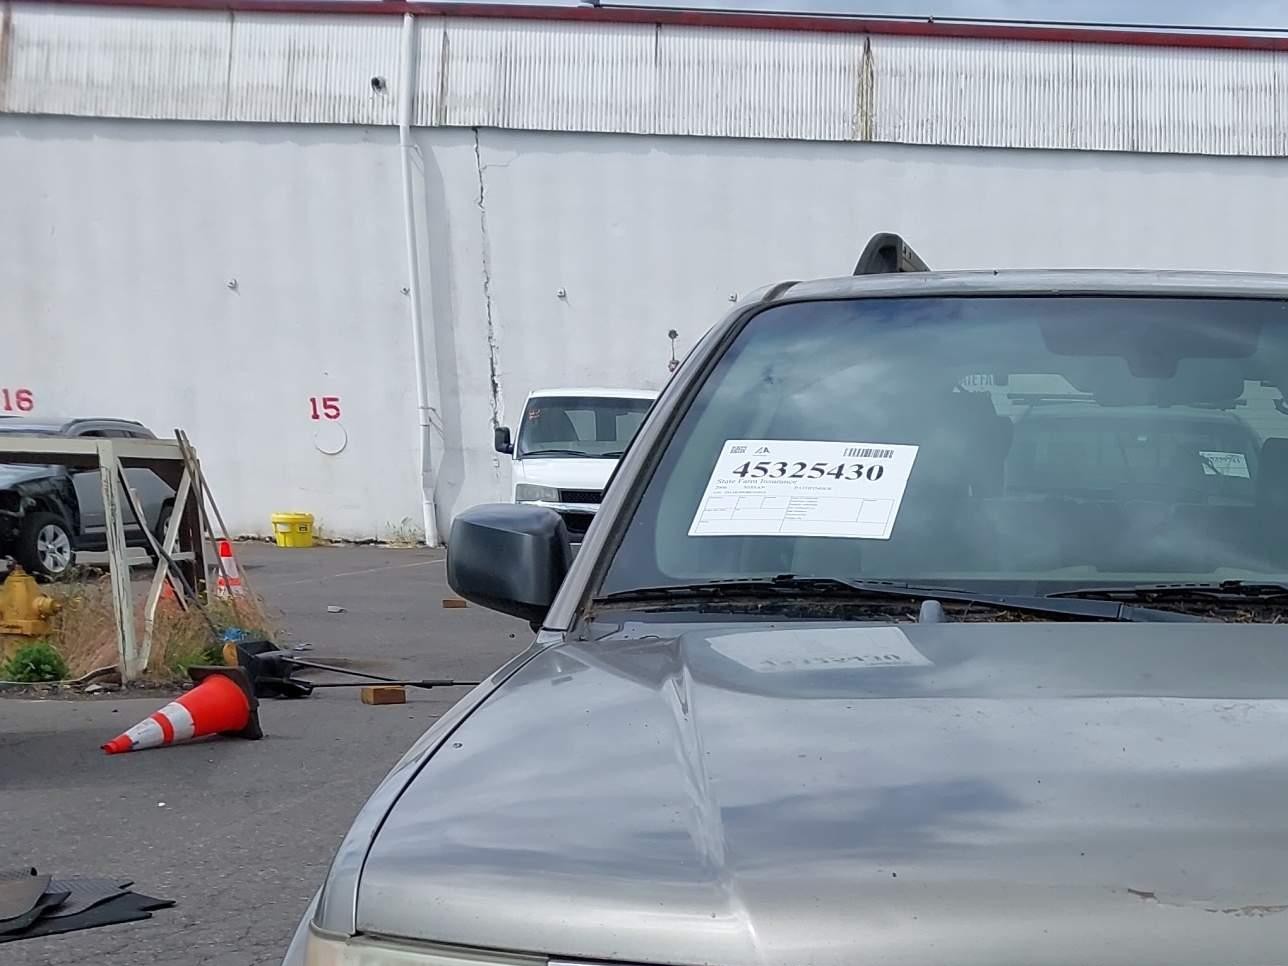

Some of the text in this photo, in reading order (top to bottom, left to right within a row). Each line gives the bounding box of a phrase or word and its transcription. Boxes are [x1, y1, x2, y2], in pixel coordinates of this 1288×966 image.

[2, 388, 34, 411] 16
[310, 397, 340, 419] 15
[732, 460, 884, 481] 45325430
